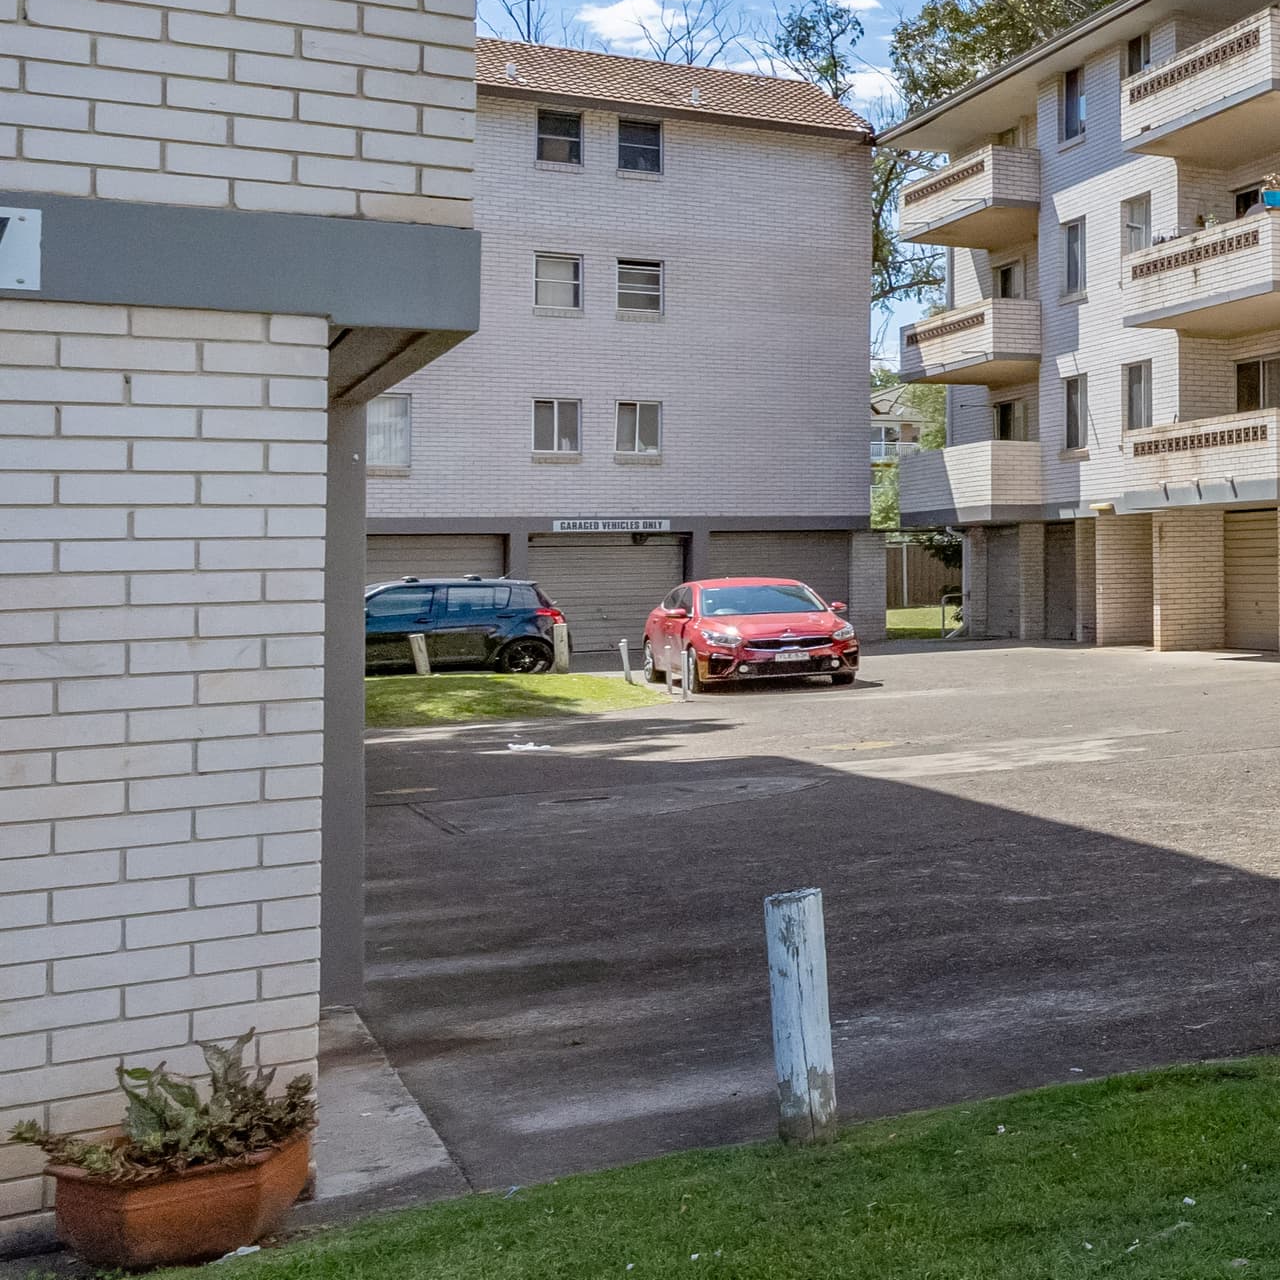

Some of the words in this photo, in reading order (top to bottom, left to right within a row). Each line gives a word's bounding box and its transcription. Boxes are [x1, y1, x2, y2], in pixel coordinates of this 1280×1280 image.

[560, 521, 599, 531] GARAGED
[602, 521, 640, 531] VEHICLES
[642, 520, 663, 530] ONLY
